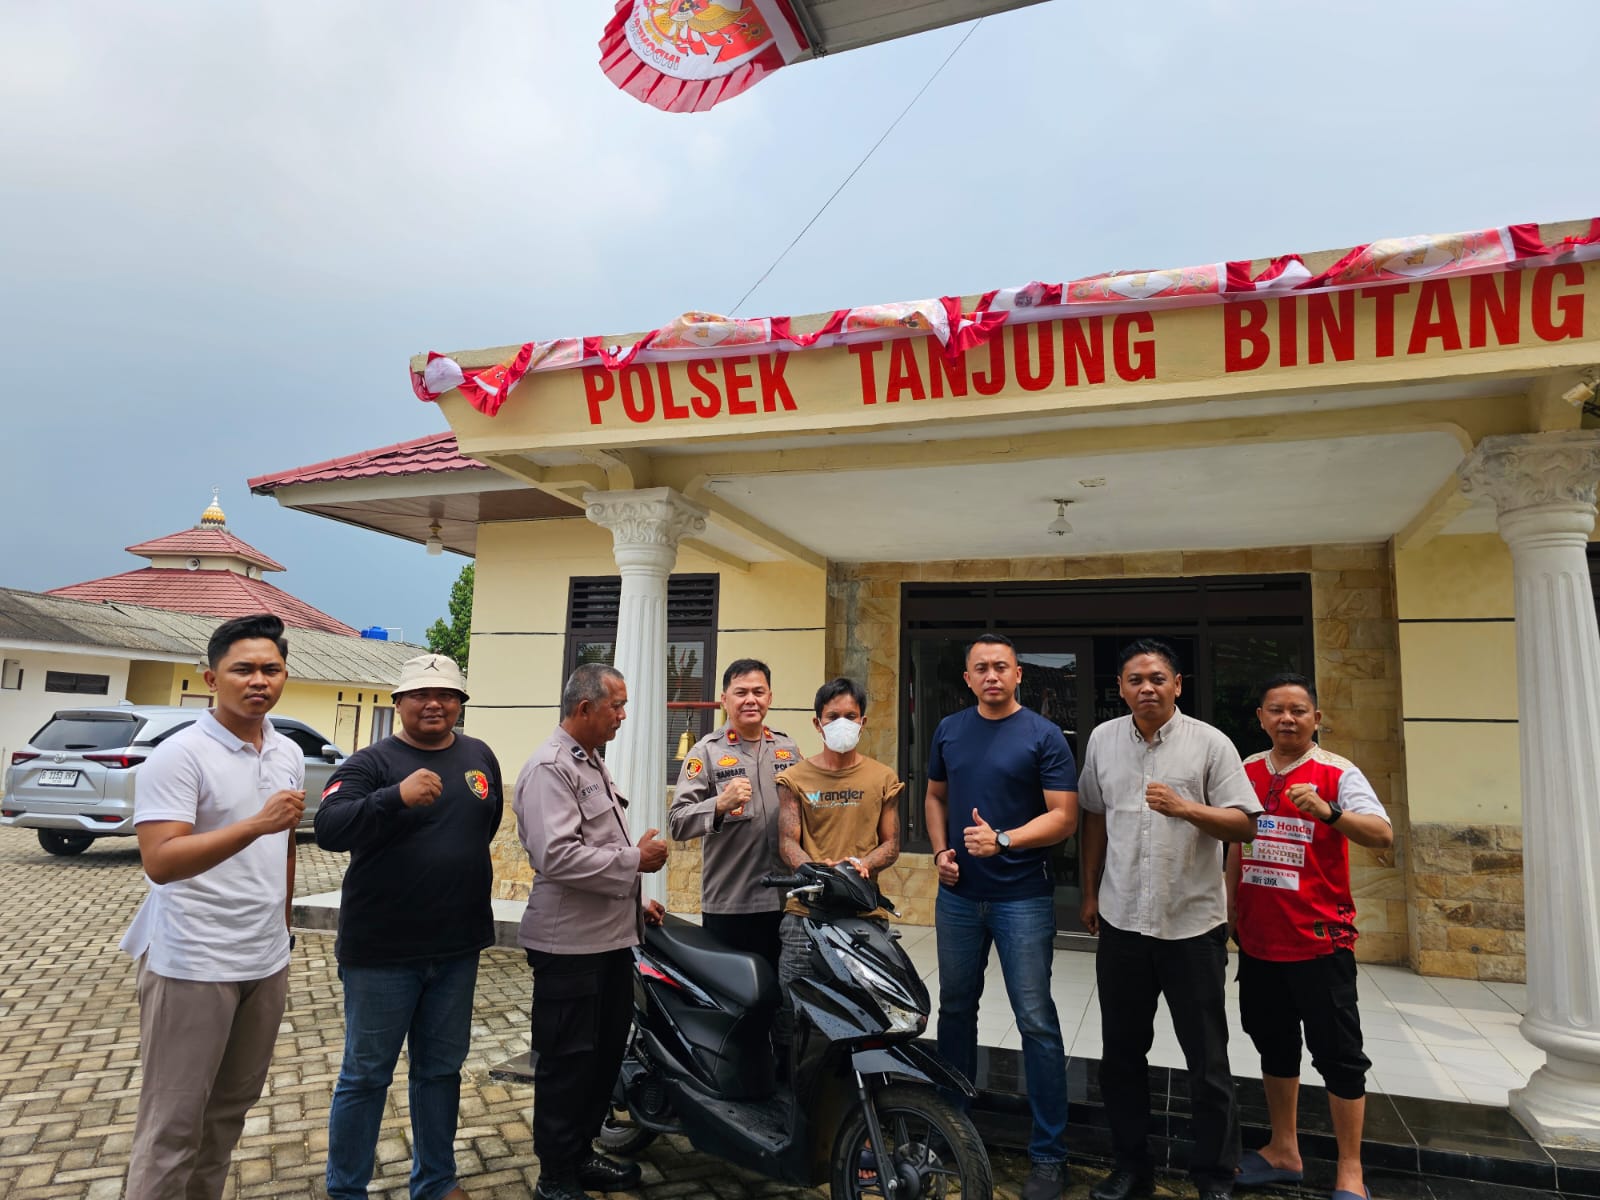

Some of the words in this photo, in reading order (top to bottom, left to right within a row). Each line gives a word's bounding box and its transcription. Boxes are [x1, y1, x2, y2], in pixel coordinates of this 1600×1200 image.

[582, 352, 798, 425] POLSEK
[848, 311, 1156, 405] TANJUNG
[1223, 262, 1585, 373] BINTANG
[805, 789, 865, 803] Wrangler
[1277, 821, 1312, 835] Honda
[1258, 848, 1303, 859] MANDIRI
